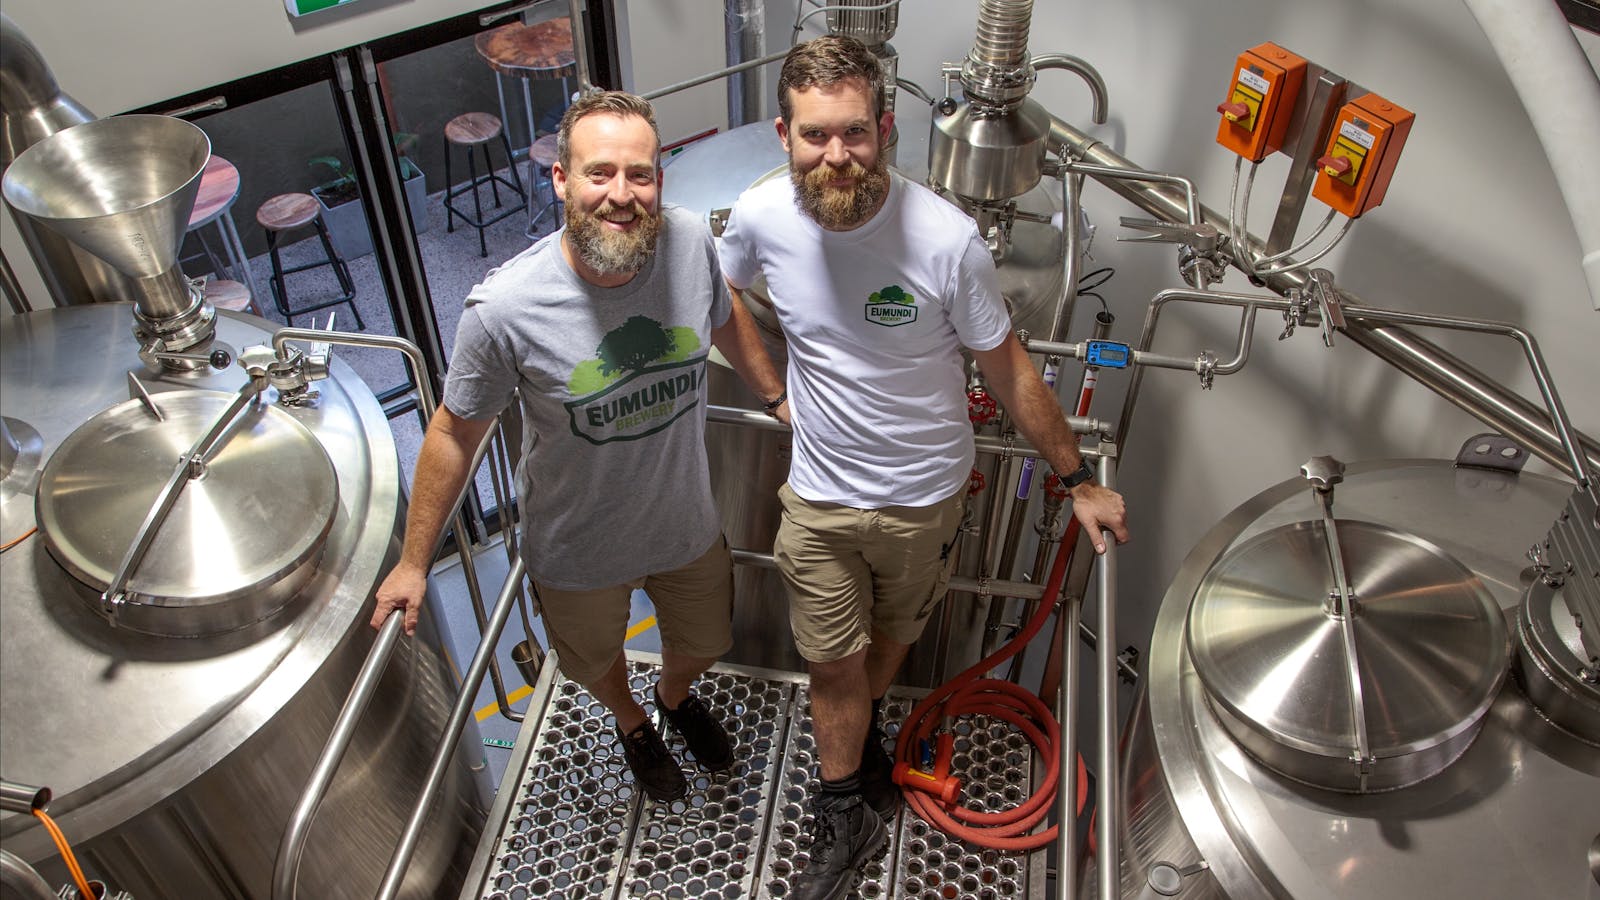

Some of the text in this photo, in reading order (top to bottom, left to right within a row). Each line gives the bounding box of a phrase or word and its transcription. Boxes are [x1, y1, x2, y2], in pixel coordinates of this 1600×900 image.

[871, 307, 911, 317] EUMUNDI
[586, 370, 697, 427] EUMUNDI
[615, 401, 675, 431] BREWERY
